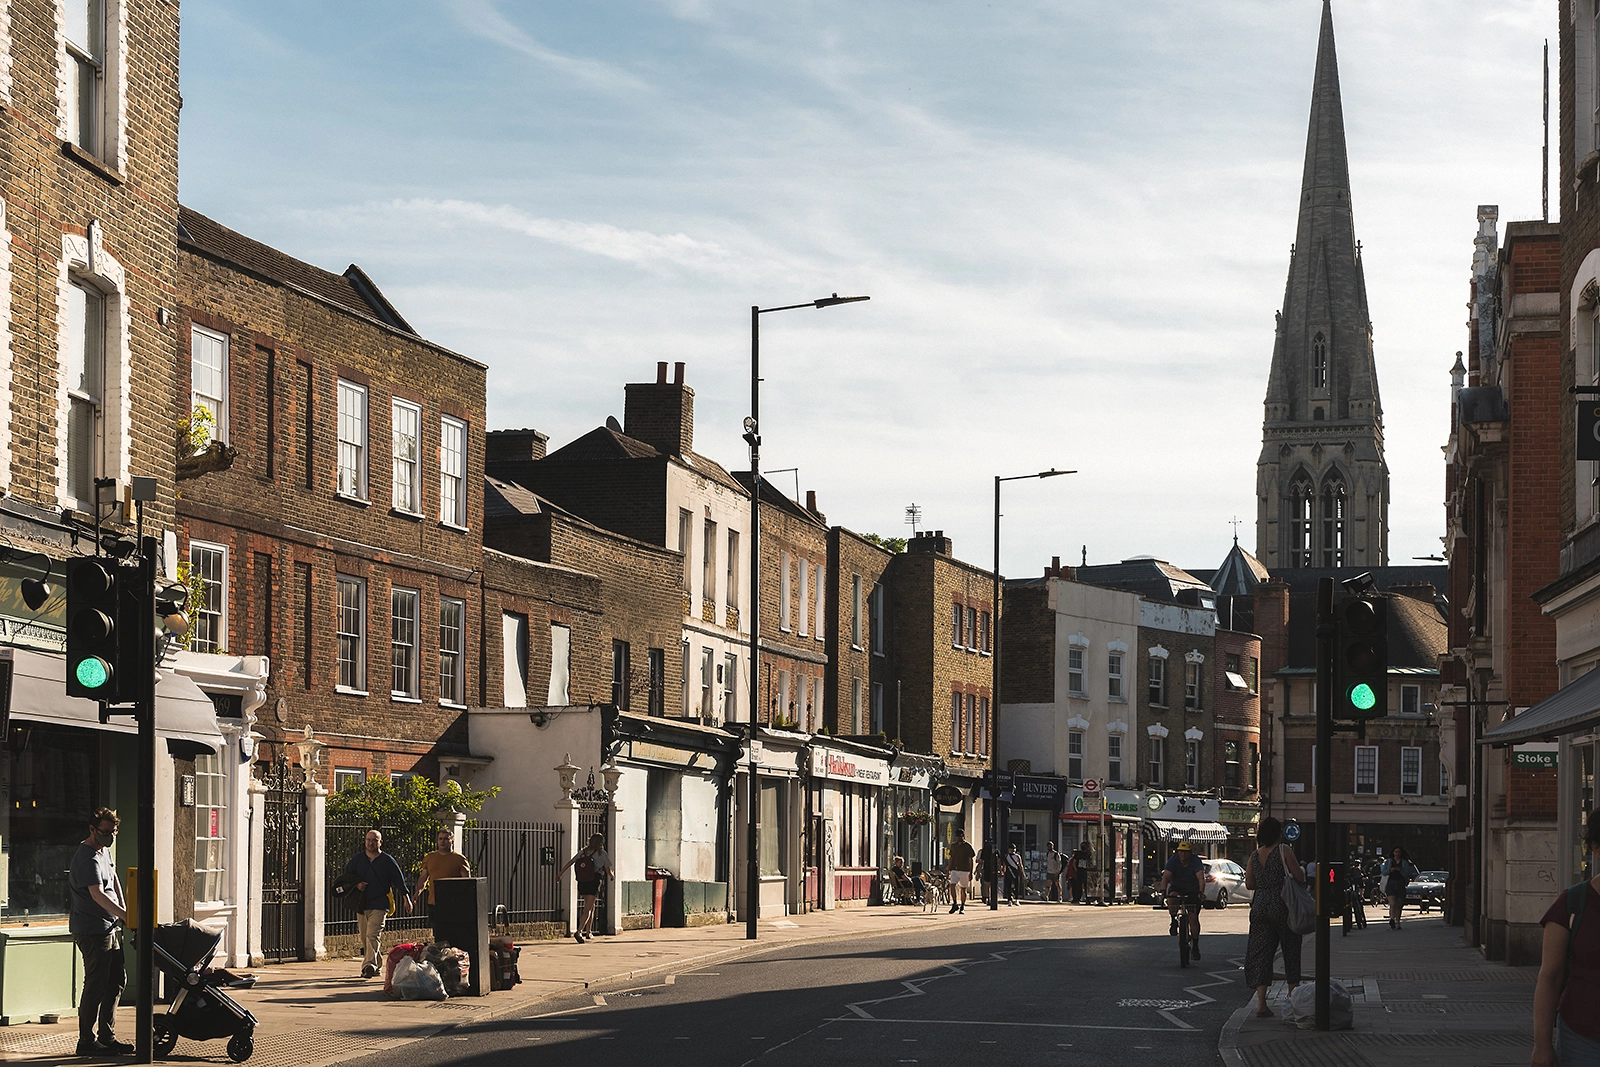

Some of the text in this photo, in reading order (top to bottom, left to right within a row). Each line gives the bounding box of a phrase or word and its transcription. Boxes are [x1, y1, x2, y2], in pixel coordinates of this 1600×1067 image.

[1517, 753, 1551, 763] Stoke
[1022, 782, 1059, 794] HUNTERS
[1176, 804, 1197, 814] JOICE
